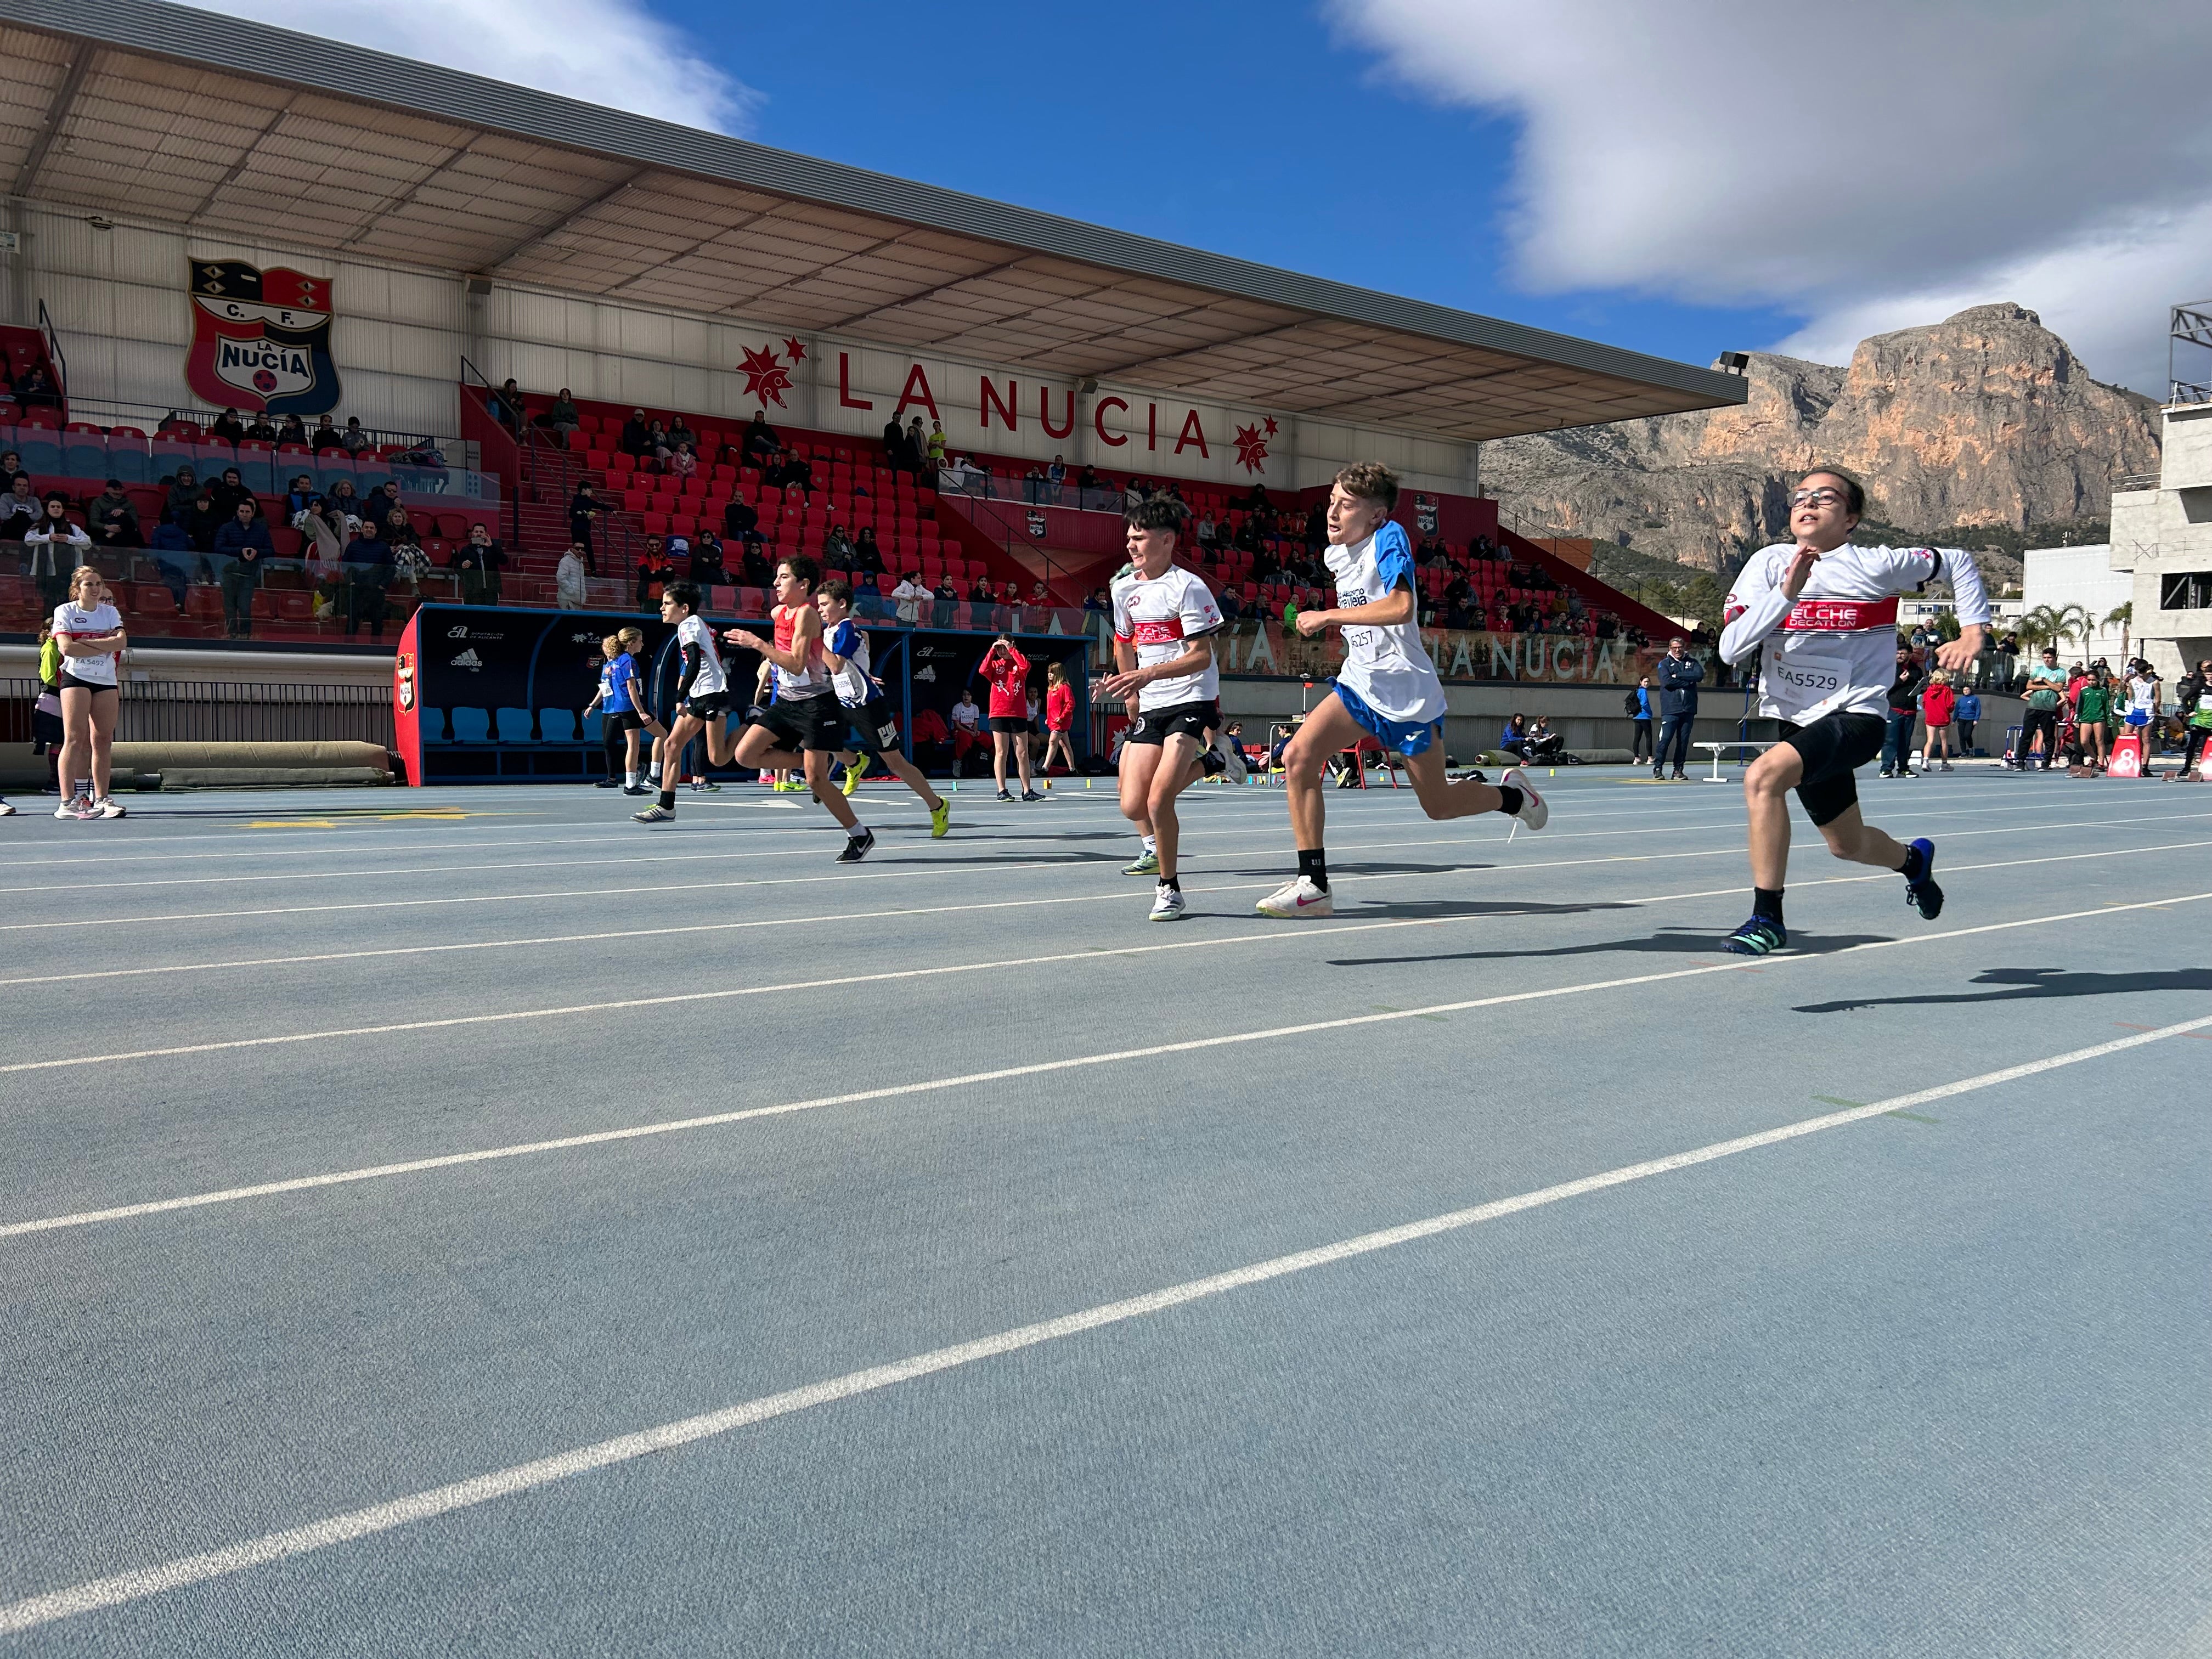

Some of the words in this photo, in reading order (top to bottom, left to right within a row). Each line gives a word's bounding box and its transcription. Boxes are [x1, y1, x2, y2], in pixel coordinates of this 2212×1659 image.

[227, 304, 245, 318] C.
[281, 311, 294, 325] F.
[257, 342, 273, 351] LA
[222, 342, 309, 379] NUCÍA
[839, 352, 940, 420] LA
[980, 375, 1210, 459] NUCIA
[1789, 619, 1856, 627] DECATLON
[1791, 608, 1857, 620] ELCHE
[1777, 667, 1837, 690] EA5529
[2119, 748, 2135, 769] 8
